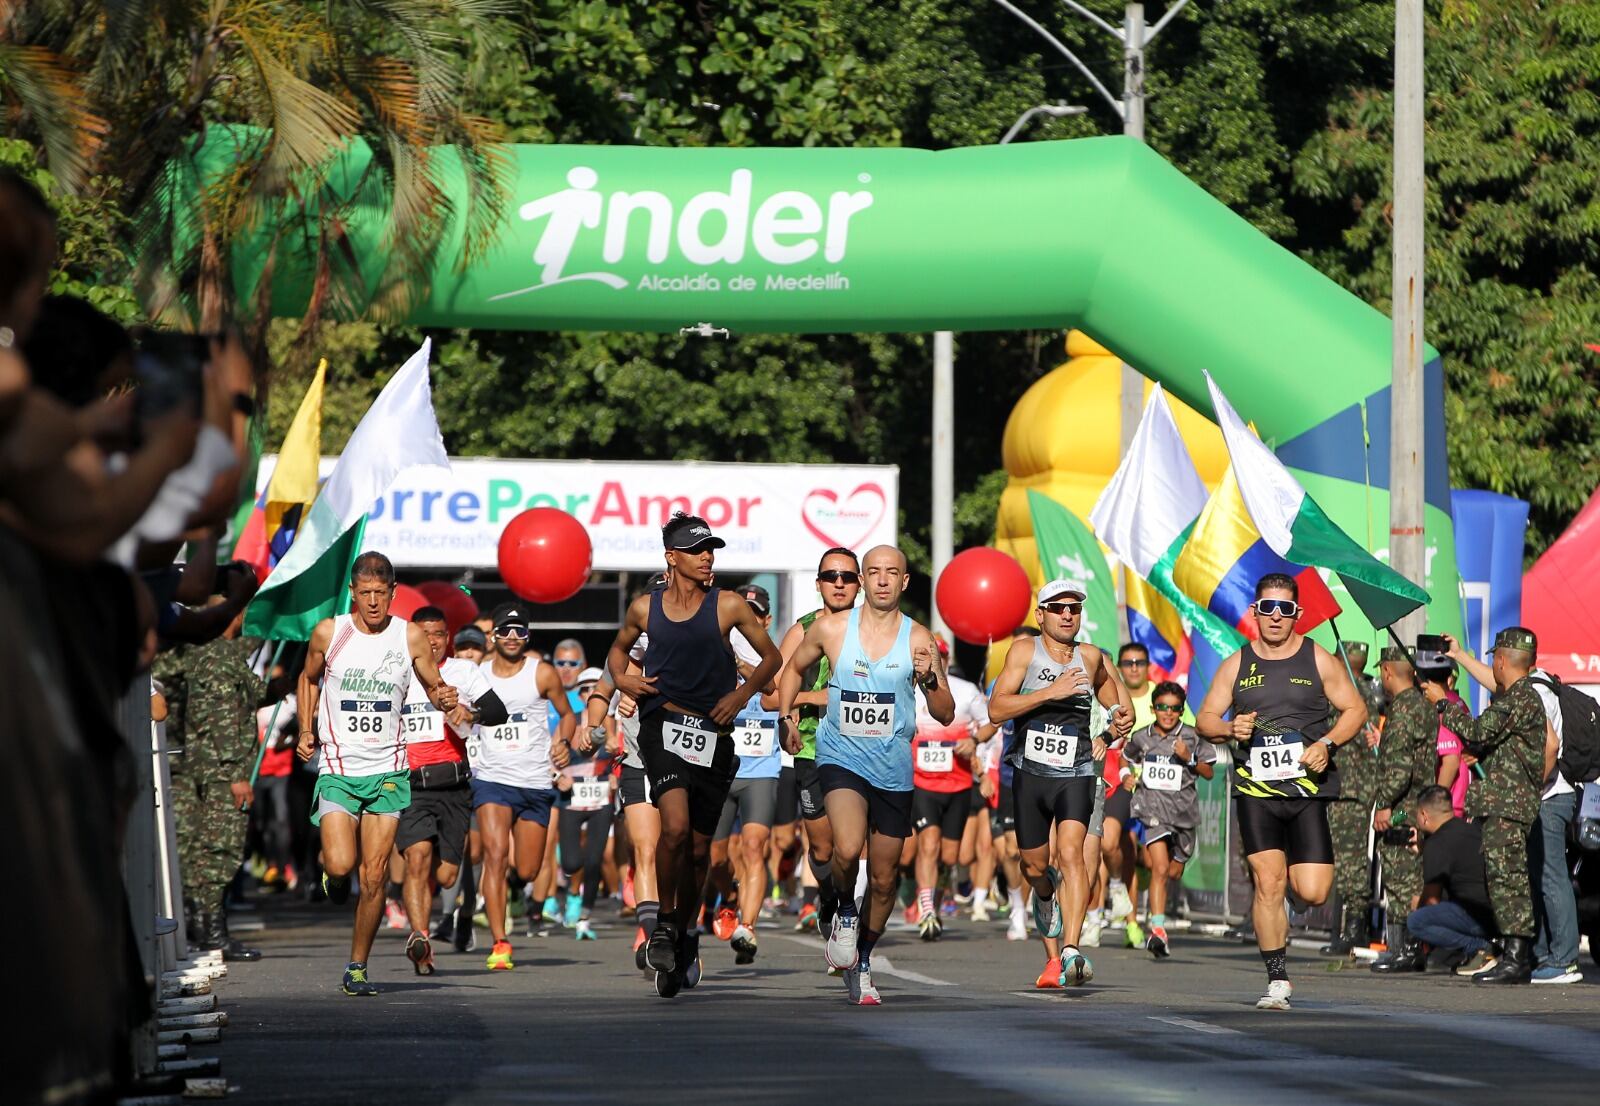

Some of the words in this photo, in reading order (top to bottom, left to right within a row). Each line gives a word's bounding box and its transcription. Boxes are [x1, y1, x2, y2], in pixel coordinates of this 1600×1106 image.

[637, 271, 721, 291] Alcaldía
[728, 273, 757, 291] de
[764, 271, 850, 291] Medellín
[344, 668, 366, 678] CLUB
[1038, 668, 1065, 682] Sa
[340, 677, 396, 695] MARATON
[1239, 674, 1265, 687] MRT
[857, 692, 878, 704] 12K
[355, 701, 376, 712] 12K
[409, 703, 428, 713] 12K
[682, 714, 704, 729] 12K
[843, 706, 890, 725] 1064
[347, 715, 383, 733] 368
[408, 716, 432, 732] 571
[745, 719, 762, 728] 12K
[1044, 723, 1064, 735] 12K
[493, 726, 519, 740] 481
[671, 728, 707, 752] 759
[743, 732, 762, 746] 32
[1033, 736, 1069, 756] 958
[1263, 735, 1285, 747] 12K
[923, 751, 946, 763] 823
[1156, 755, 1171, 764] 12K
[1260, 749, 1293, 768] 814
[1148, 766, 1176, 780] 860
[579, 787, 602, 798] 616
